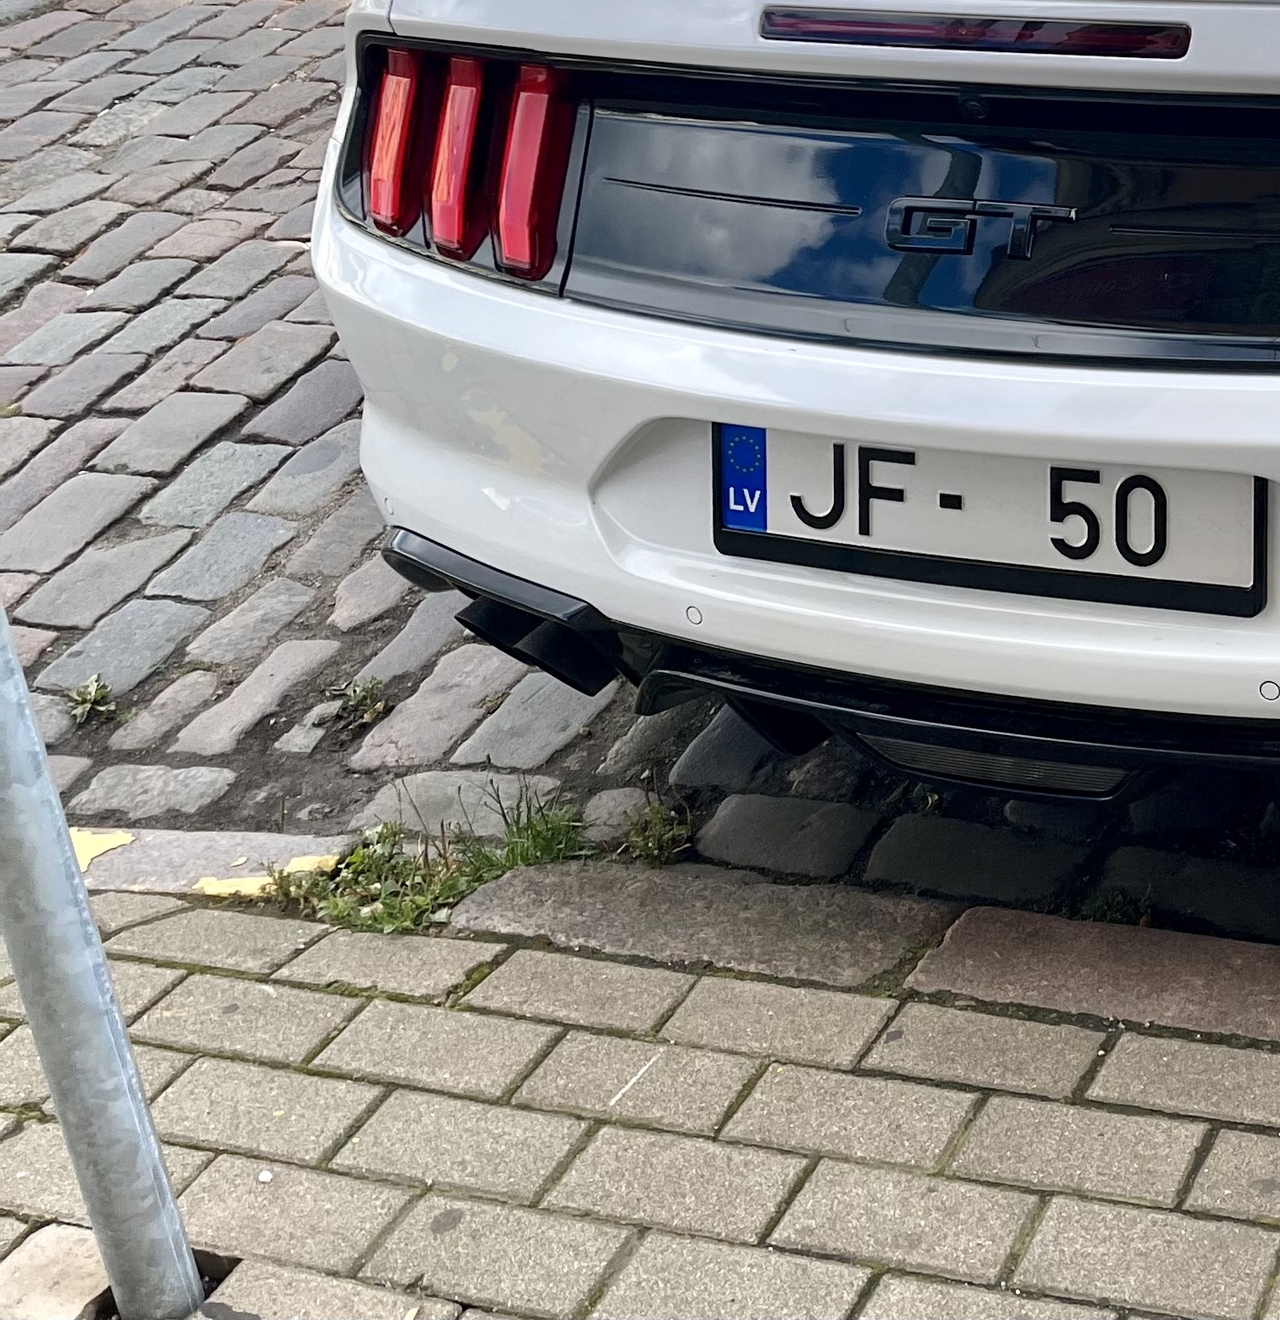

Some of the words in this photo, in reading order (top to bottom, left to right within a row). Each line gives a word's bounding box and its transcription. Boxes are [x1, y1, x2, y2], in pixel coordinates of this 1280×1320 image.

[884, 196, 1078, 260] GT
[729, 487, 761, 513] LV
[1050, 466, 1168, 567] 50
